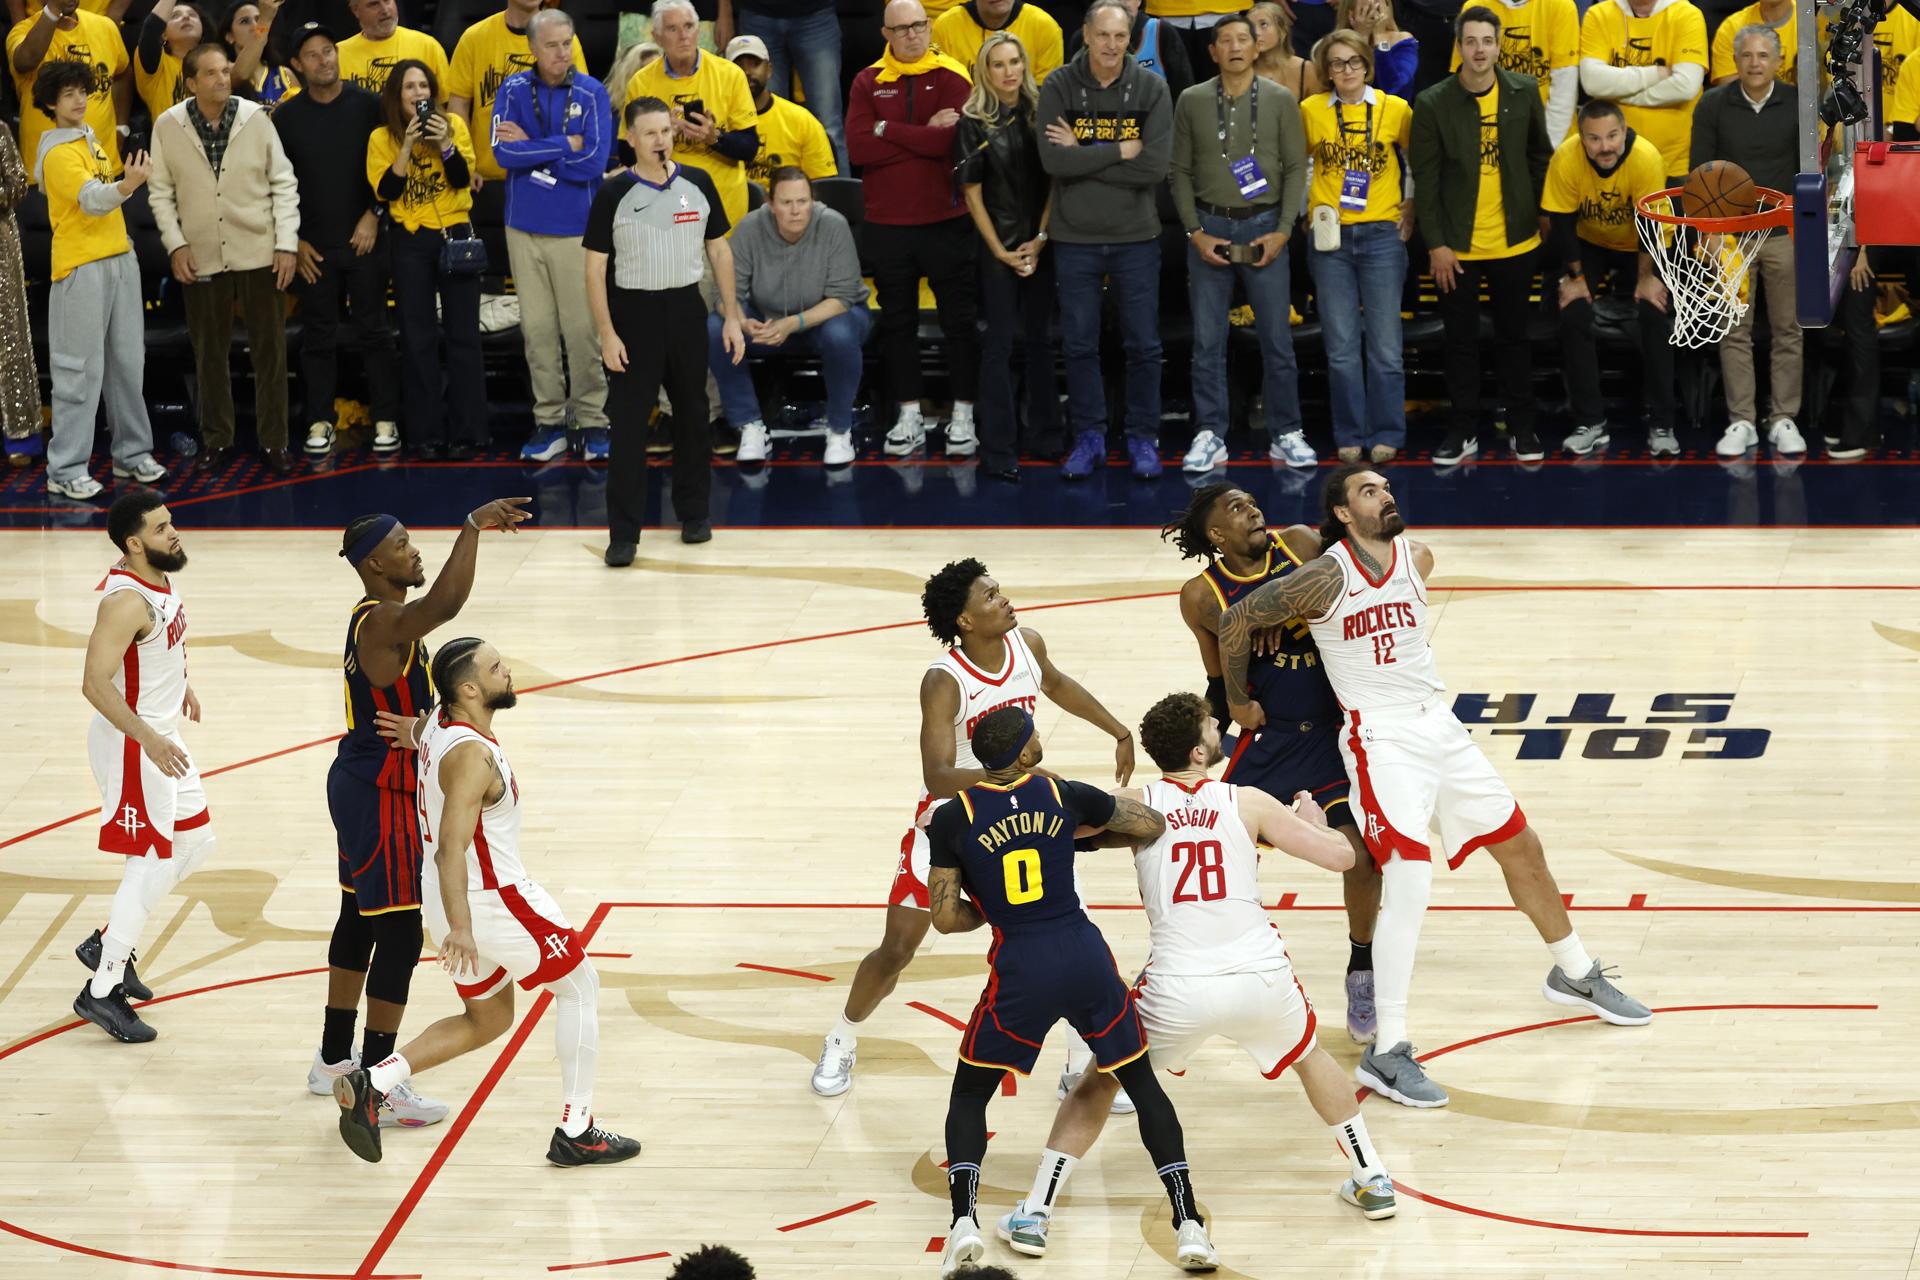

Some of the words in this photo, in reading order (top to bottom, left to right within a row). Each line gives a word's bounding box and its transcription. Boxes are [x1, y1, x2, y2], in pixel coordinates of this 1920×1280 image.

[1112, 118, 1136, 127] SATE
[1343, 602, 1417, 641] ROCKETS
[1273, 653, 1318, 670] STA
[1371, 633, 1398, 666] 12
[1466, 728, 1773, 760] GOL
[978, 811, 1046, 853] PAYTON
[1047, 817, 1064, 838] II
[1002, 848, 1044, 905] 0
[1171, 840, 1227, 904] 28
